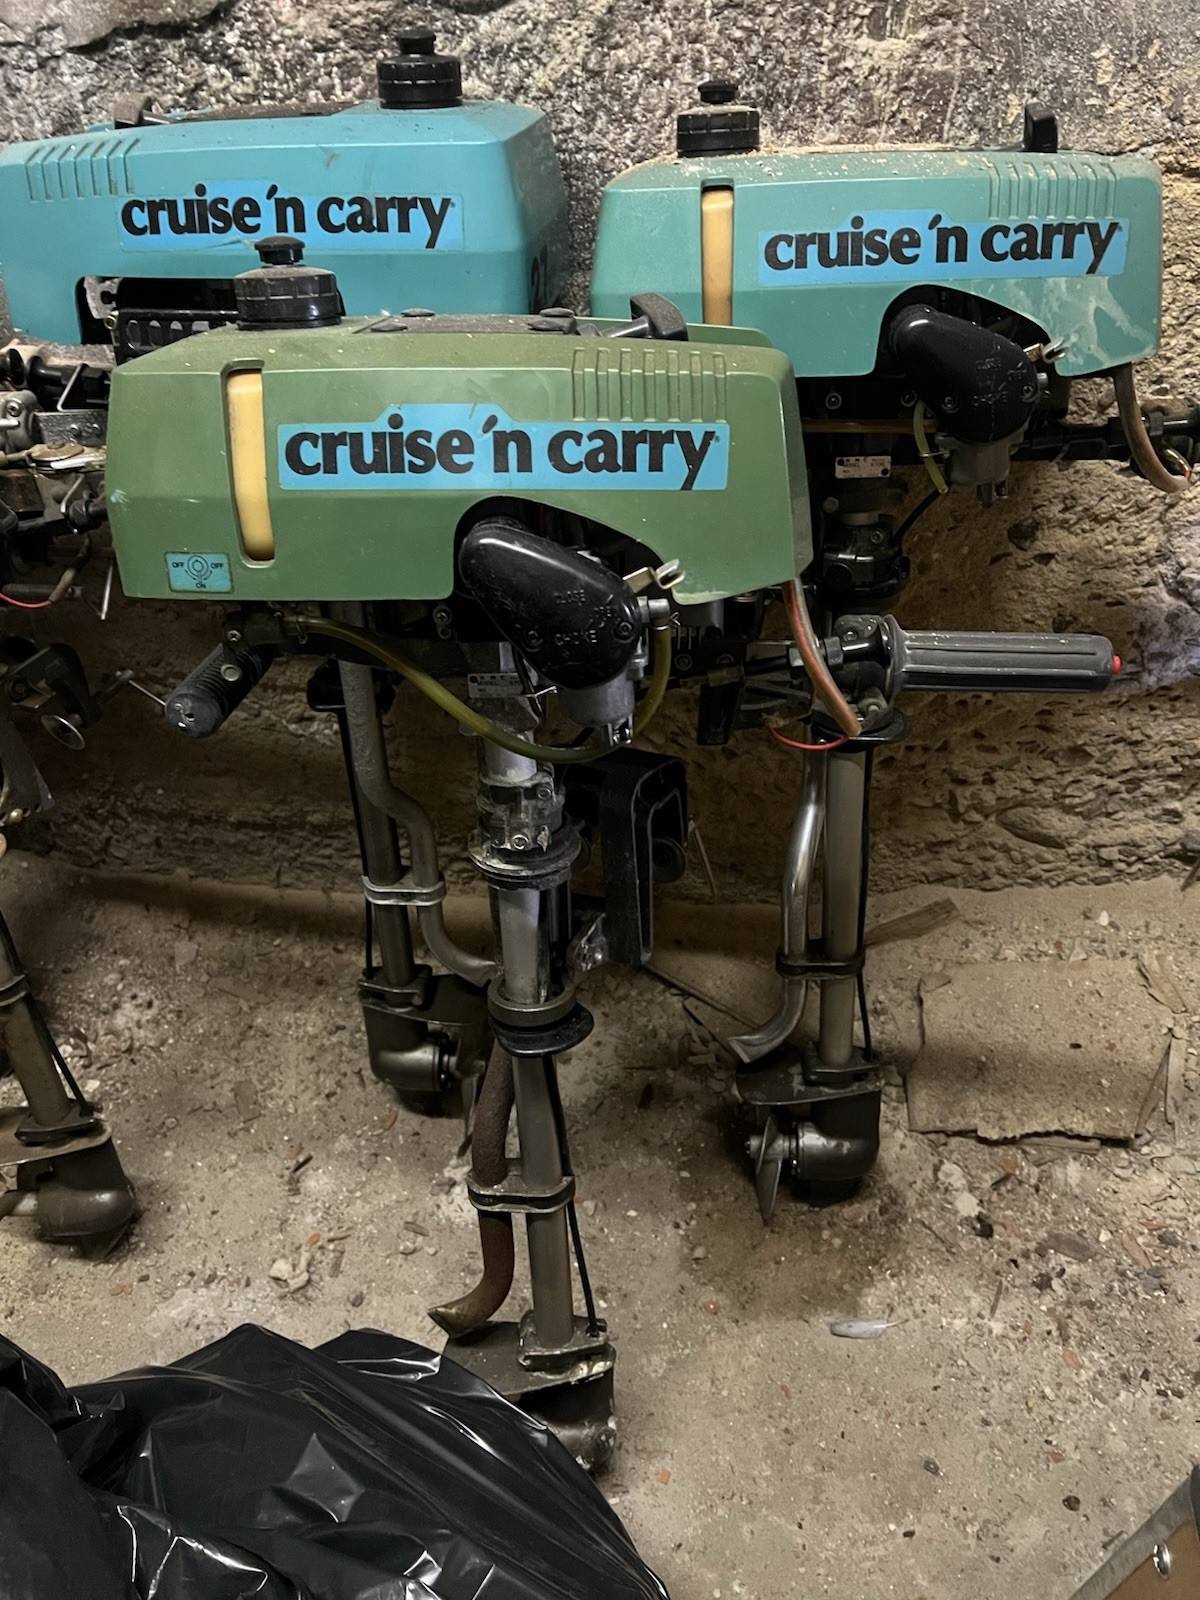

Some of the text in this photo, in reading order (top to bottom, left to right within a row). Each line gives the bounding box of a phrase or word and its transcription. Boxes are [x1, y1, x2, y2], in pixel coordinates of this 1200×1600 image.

[316, 195, 451, 249] carry
[980, 221, 1119, 275] carry
[547, 430, 716, 491] carry
[171, 561, 224, 570] OFF OFF
[195, 581, 207, 589] ON
[555, 629, 598, 647] CHOKE
